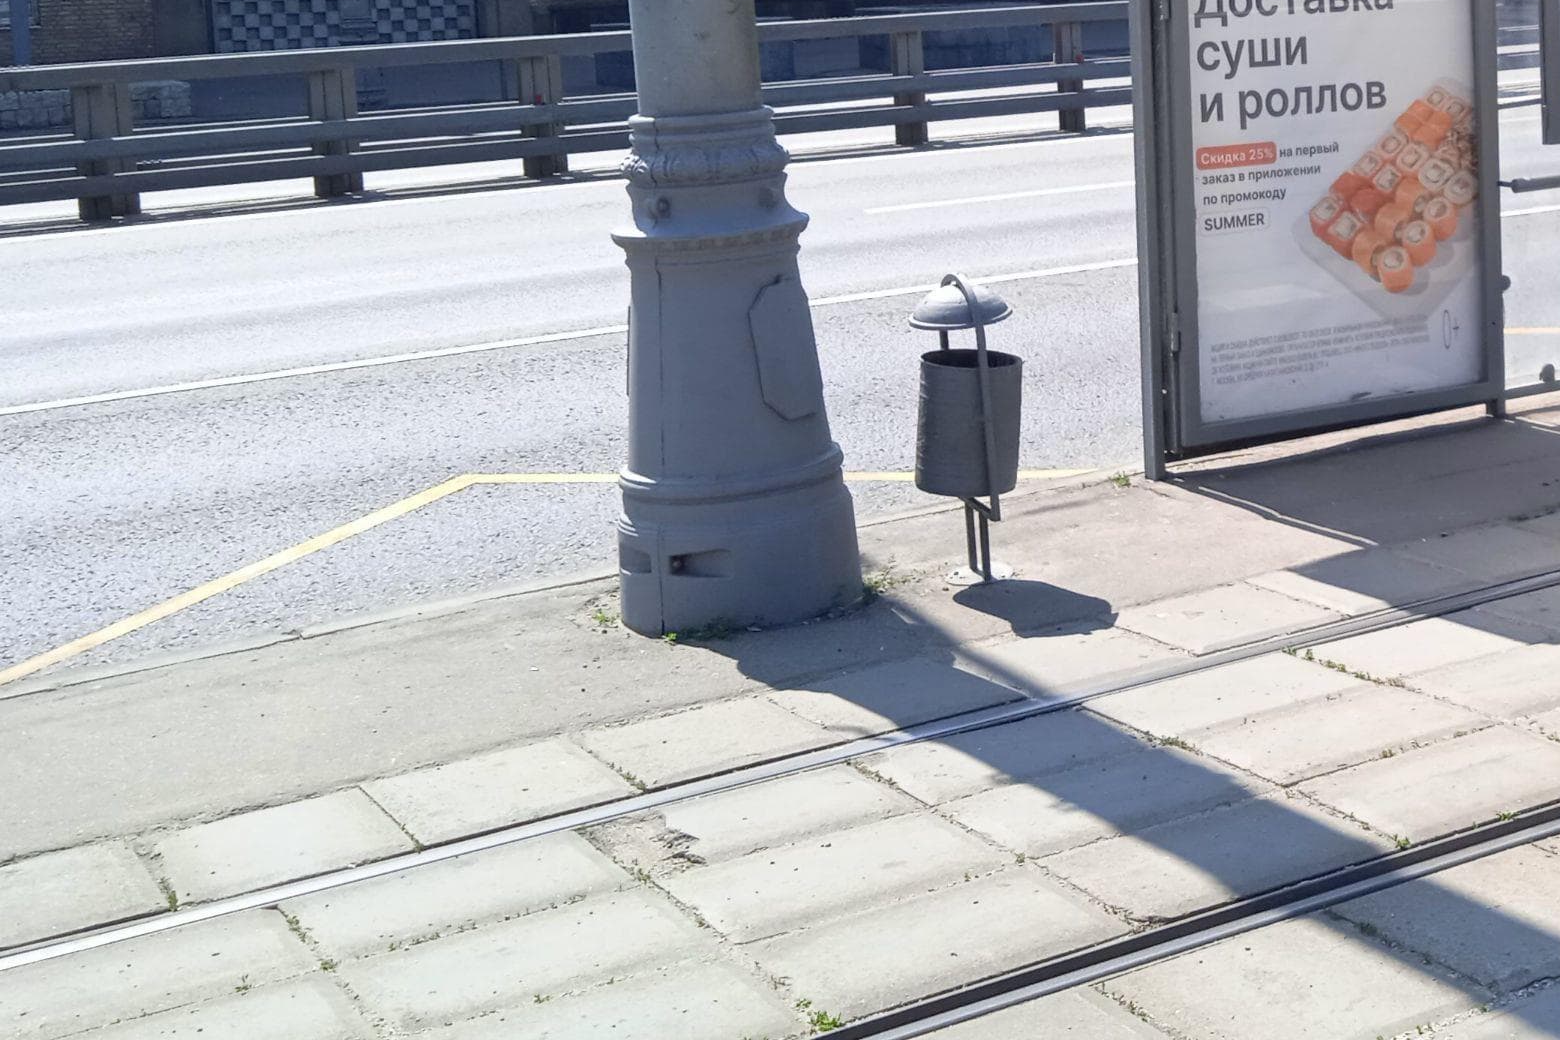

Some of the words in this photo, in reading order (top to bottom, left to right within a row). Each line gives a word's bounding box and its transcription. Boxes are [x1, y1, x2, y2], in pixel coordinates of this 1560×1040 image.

[1196, 35, 1308, 80] суши
[1200, 92, 1224, 123] и
[1238, 80, 1387, 130] роллов
[1200, 150, 1246, 165] Скидка
[1249, 147, 1273, 161] 25%
[1279, 147, 1293, 158] на
[1295, 141, 1340, 158] первый
[1201, 172, 1236, 185] заказ
[1238, 171, 1245, 182] в
[1248, 165, 1321, 183] приложении
[1203, 195, 1217, 206] по
[1220, 188, 1287, 206] промокоду
[1204, 212, 1265, 232] SUMMER
